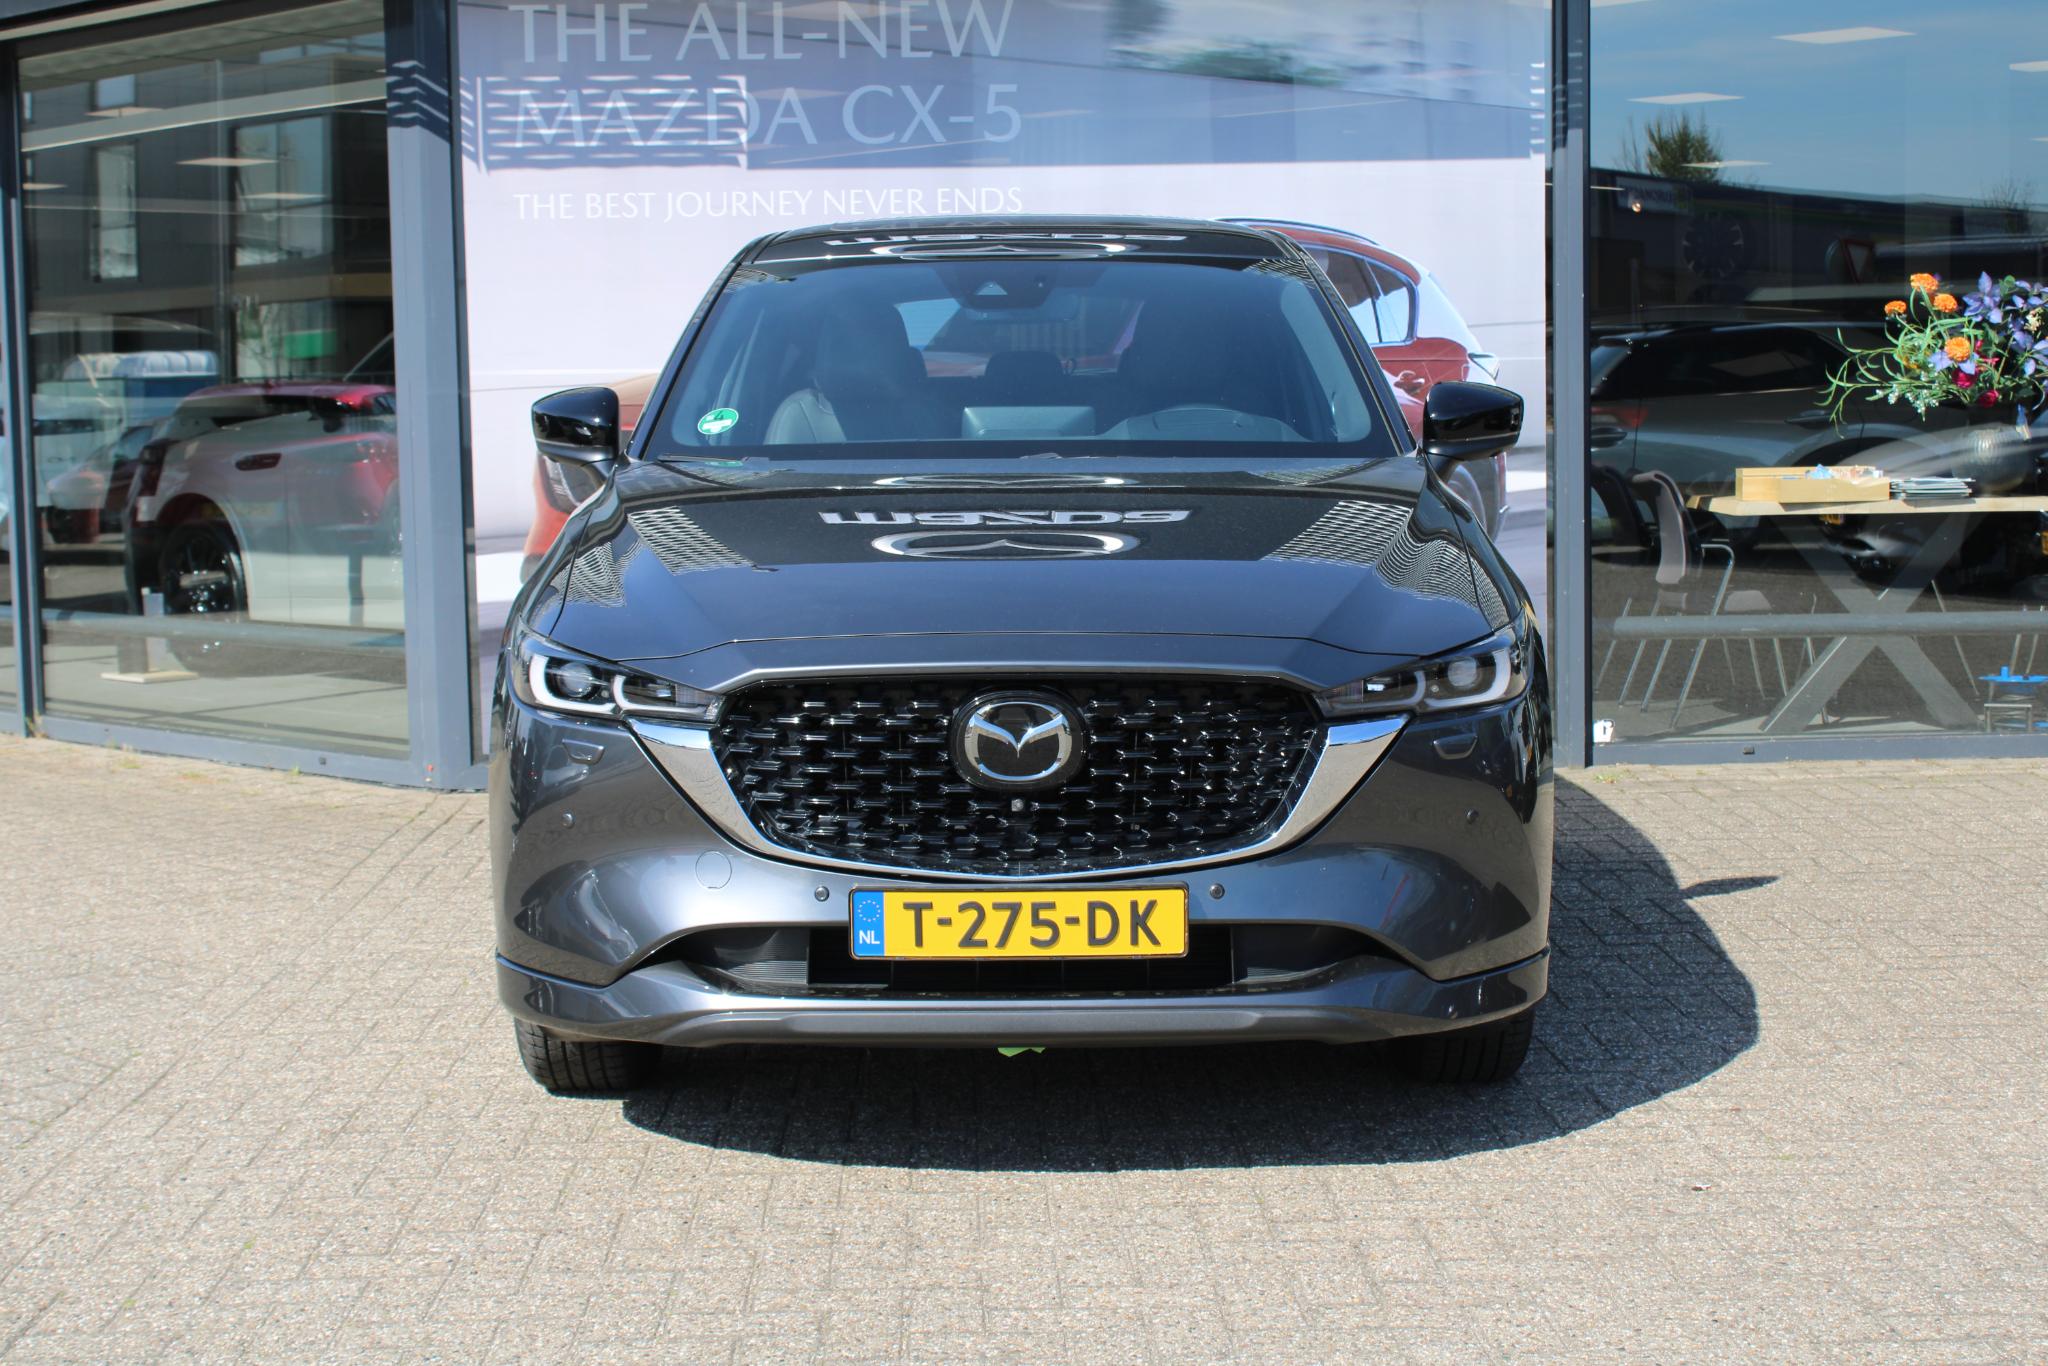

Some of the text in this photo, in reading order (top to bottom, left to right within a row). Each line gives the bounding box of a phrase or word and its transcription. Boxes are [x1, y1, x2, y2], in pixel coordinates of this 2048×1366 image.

[508, 0, 1015, 63] THE ALL-NEW
[515, 83, 1021, 148] MAZDA CX-5
[512, 186, 1023, 223] THE BEST JOURNEY NEVER ENDS
[858, 930, 881, 945] NL
[901, 899, 1162, 949] T-275-DK
